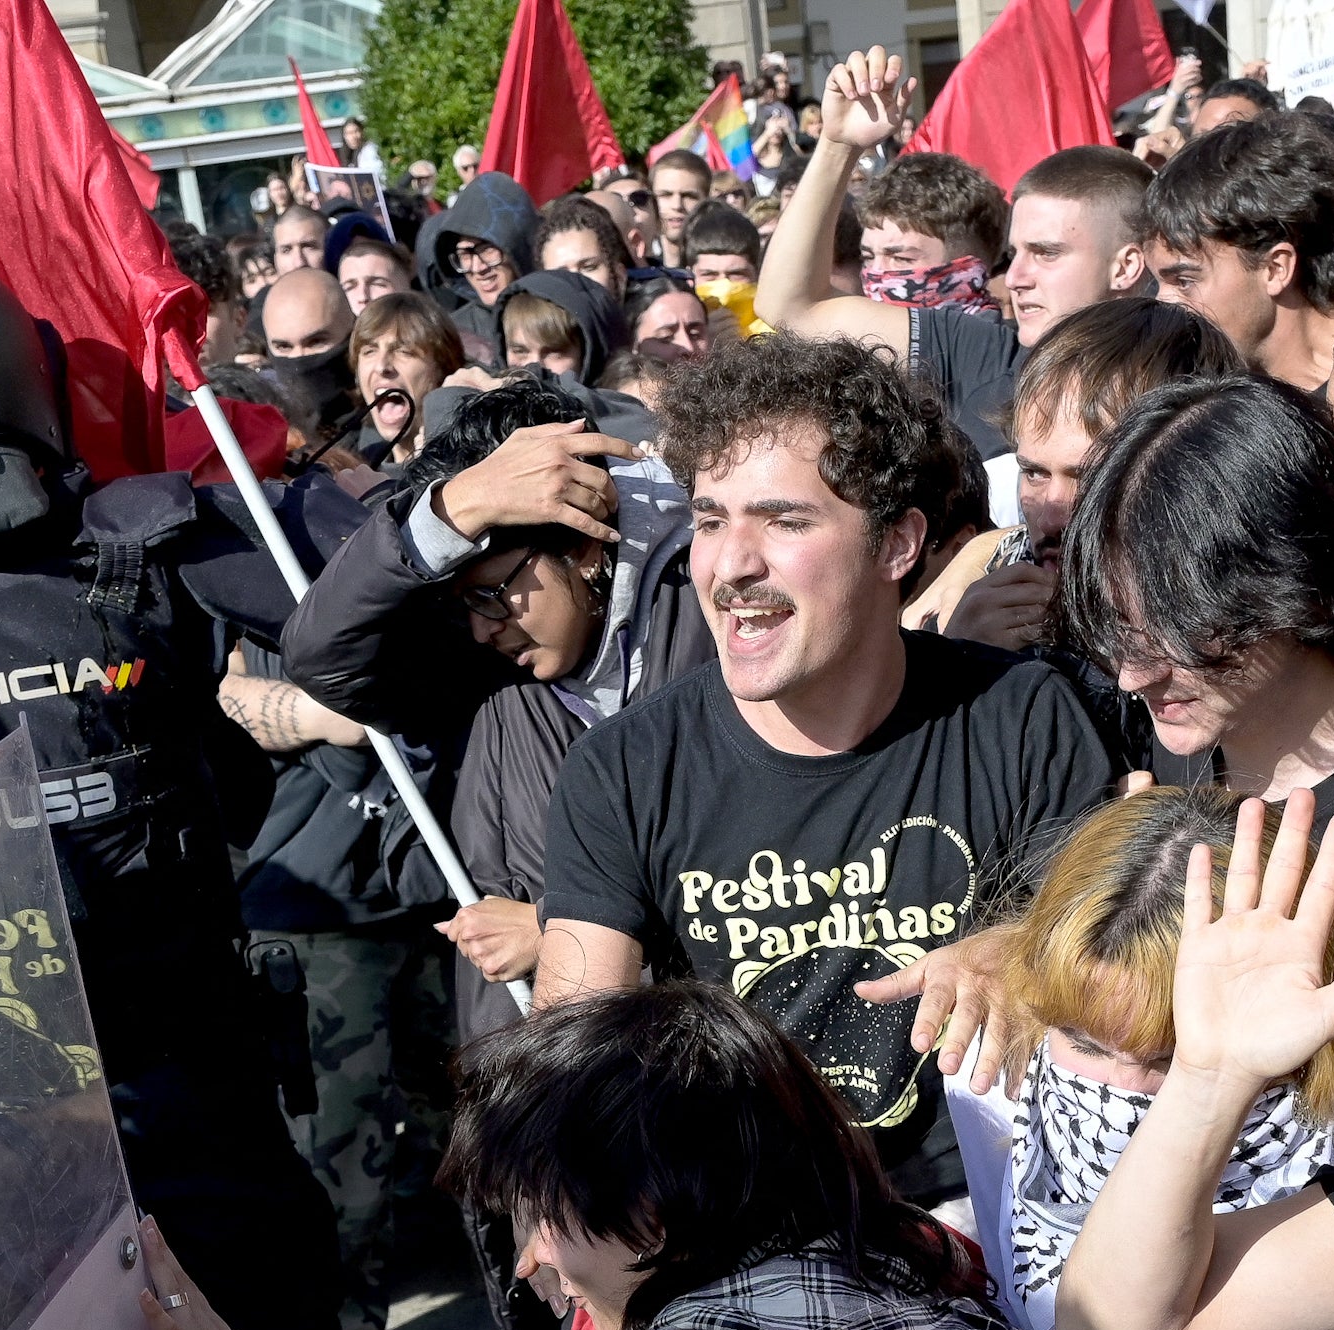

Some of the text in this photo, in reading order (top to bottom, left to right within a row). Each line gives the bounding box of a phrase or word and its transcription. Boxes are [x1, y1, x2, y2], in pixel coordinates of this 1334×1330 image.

[902, 814, 938, 829] EDICIÓN
[678, 847, 887, 914] Festival
[688, 898, 956, 960] de Pardiñas
